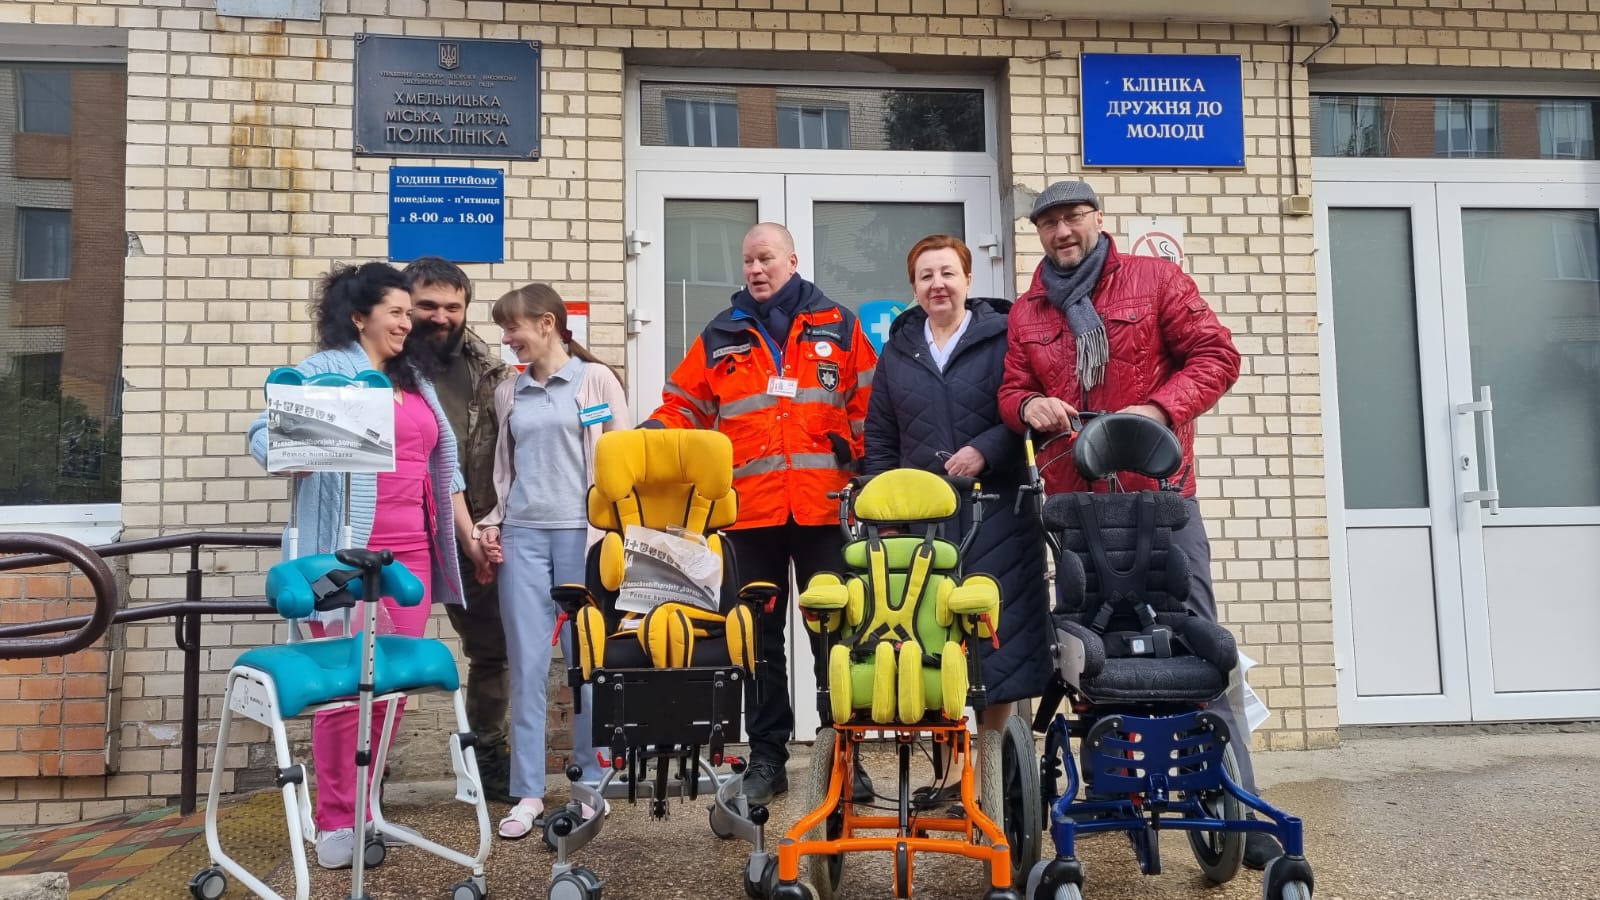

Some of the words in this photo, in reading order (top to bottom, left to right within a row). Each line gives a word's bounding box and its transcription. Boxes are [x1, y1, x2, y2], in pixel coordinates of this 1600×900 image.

[1122, 77, 1206, 92] КЛІНІКА
[395, 91, 501, 107] ХМЕЛЬНИЦЬКА
[386, 109, 442, 123] МІСЬКА
[454, 111, 510, 125] ДИТЯЧА
[1106, 101, 1191, 117] ДРУЖНЯ
[1196, 101, 1223, 118] ДО
[386, 126, 509, 145] ПОЛІКЛІНІКА
[1126, 124, 1205, 141] МОЛОДІ
[396, 175, 440, 184] ГОДИНИ
[444, 176, 497, 185] ПРИЙОМУ
[394, 195, 444, 204] понеділок
[409, 212, 438, 223] 8-00
[459, 213, 494, 224] 18.00
